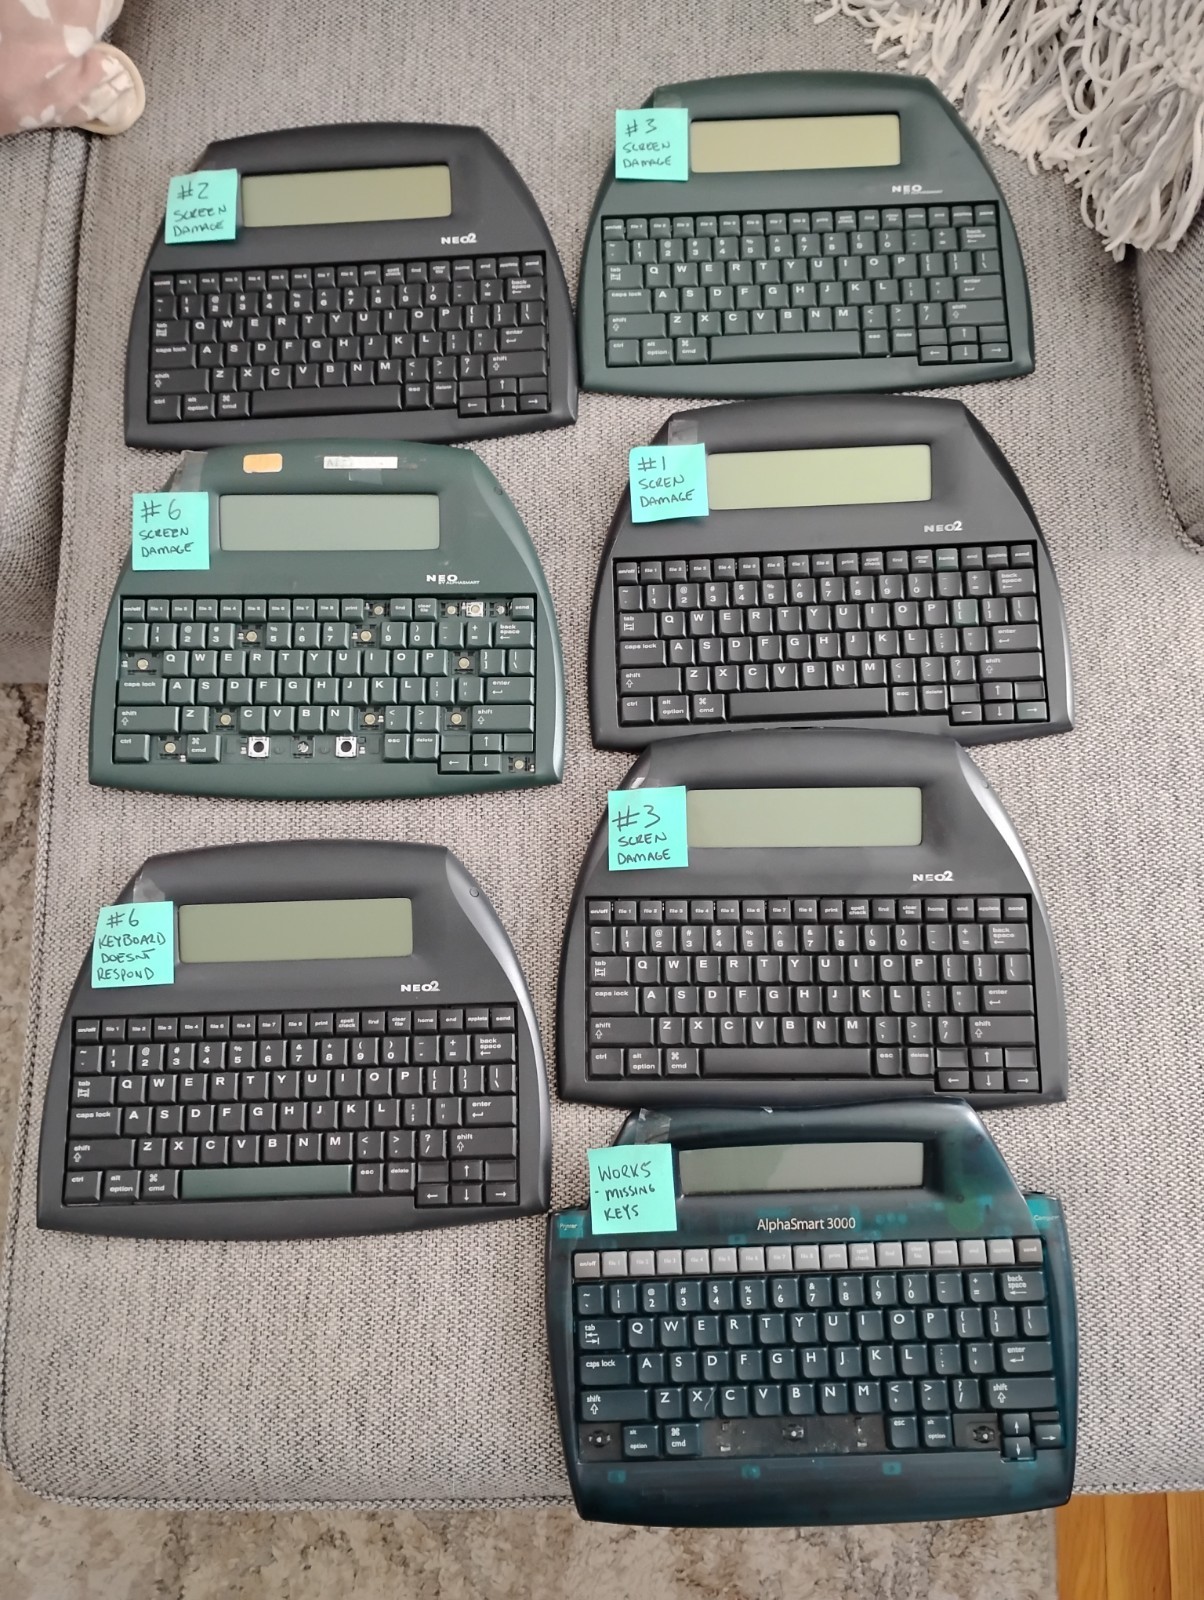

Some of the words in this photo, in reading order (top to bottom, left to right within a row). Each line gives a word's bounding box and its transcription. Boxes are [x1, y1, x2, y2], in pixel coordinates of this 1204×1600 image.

[625, 118, 657, 137] #3
[622, 141, 671, 153] SCREEN
[622, 155, 672, 168] DAMAGE
[176, 181, 209, 200] #2
[891, 184, 923, 193] NEO
[173, 204, 227, 222] SCREEN
[172, 220, 225, 237] DAMAGE
[440, 232, 477, 245] NEO2
[637, 455, 666, 472] #1
[638, 473, 685, 489] SCREN
[639, 488, 696, 508] DAMAGE
[140, 498, 182, 523] #6
[138, 527, 190, 541] SCREEN
[924, 520, 963, 533] NEO2
[141, 541, 195, 558] DAMAGE
[426, 574, 458, 582] NEO
[664, 615, 674, 623] Q
[693, 613, 704, 622] W
[723, 612, 731, 621] E
[752, 611, 760, 620] R
[781, 609, 789, 618] T
[810, 608, 818, 617] Y
[839, 607, 848, 616] U
[897, 605, 908, 613] O
[927, 603, 936, 612] P
[166, 654, 176, 662] Q
[194, 653, 206, 661] W
[224, 653, 232, 661] E
[253, 653, 262, 661] R
[281, 653, 290, 661] T
[310, 653, 319, 661] Y
[339, 653, 348, 661] U
[396, 653, 406, 661] O
[426, 652, 434, 660] P
[611, 804, 661, 832] #3
[617, 831, 668, 847] SCREN
[617, 848, 671, 865] DAMAGE
[912, 870, 954, 882] NEO2
[105, 908, 140, 929] #6
[98, 931, 167, 949] KEYBOARD
[637, 960, 648, 969] Q
[668, 960, 680, 969] W
[699, 959, 708, 968] E
[729, 959, 738, 968] R
[760, 959, 768, 968] T
[790, 959, 799, 968] Y
[821, 959, 830, 968] U
[883, 958, 893, 968] O
[914, 958, 923, 967] P
[96, 966, 155, 982] RESPOND
[400, 980, 441, 992] NEO2
[121, 1079, 132, 1089] Q
[153, 1078, 165, 1087] W
[184, 1077, 193, 1087] E
[215, 1076, 225, 1086] R
[246, 1075, 255, 1085] T
[277, 1075, 286, 1084] Y
[307, 1074, 317, 1083] U
[369, 1072, 380, 1081] O
[401, 1071, 410, 1080] P
[597, 1160, 652, 1182] WORKS
[604, 1183, 656, 1202] MISSING
[603, 1203, 639, 1221] KEYS
[757, 1217, 825, 1234] AlphaSmart
[827, 1216, 856, 1230] 3000
[632, 1322, 643, 1334] Q
[664, 1321, 679, 1332] W
[698, 1320, 705, 1331] E
[730, 1319, 739, 1330] R
[761, 1317, 771, 1329] T
[795, 1316, 804, 1327] Y
[828, 1315, 838, 1326] U
[893, 1313, 905, 1325] O
[926, 1312, 935, 1323] P
